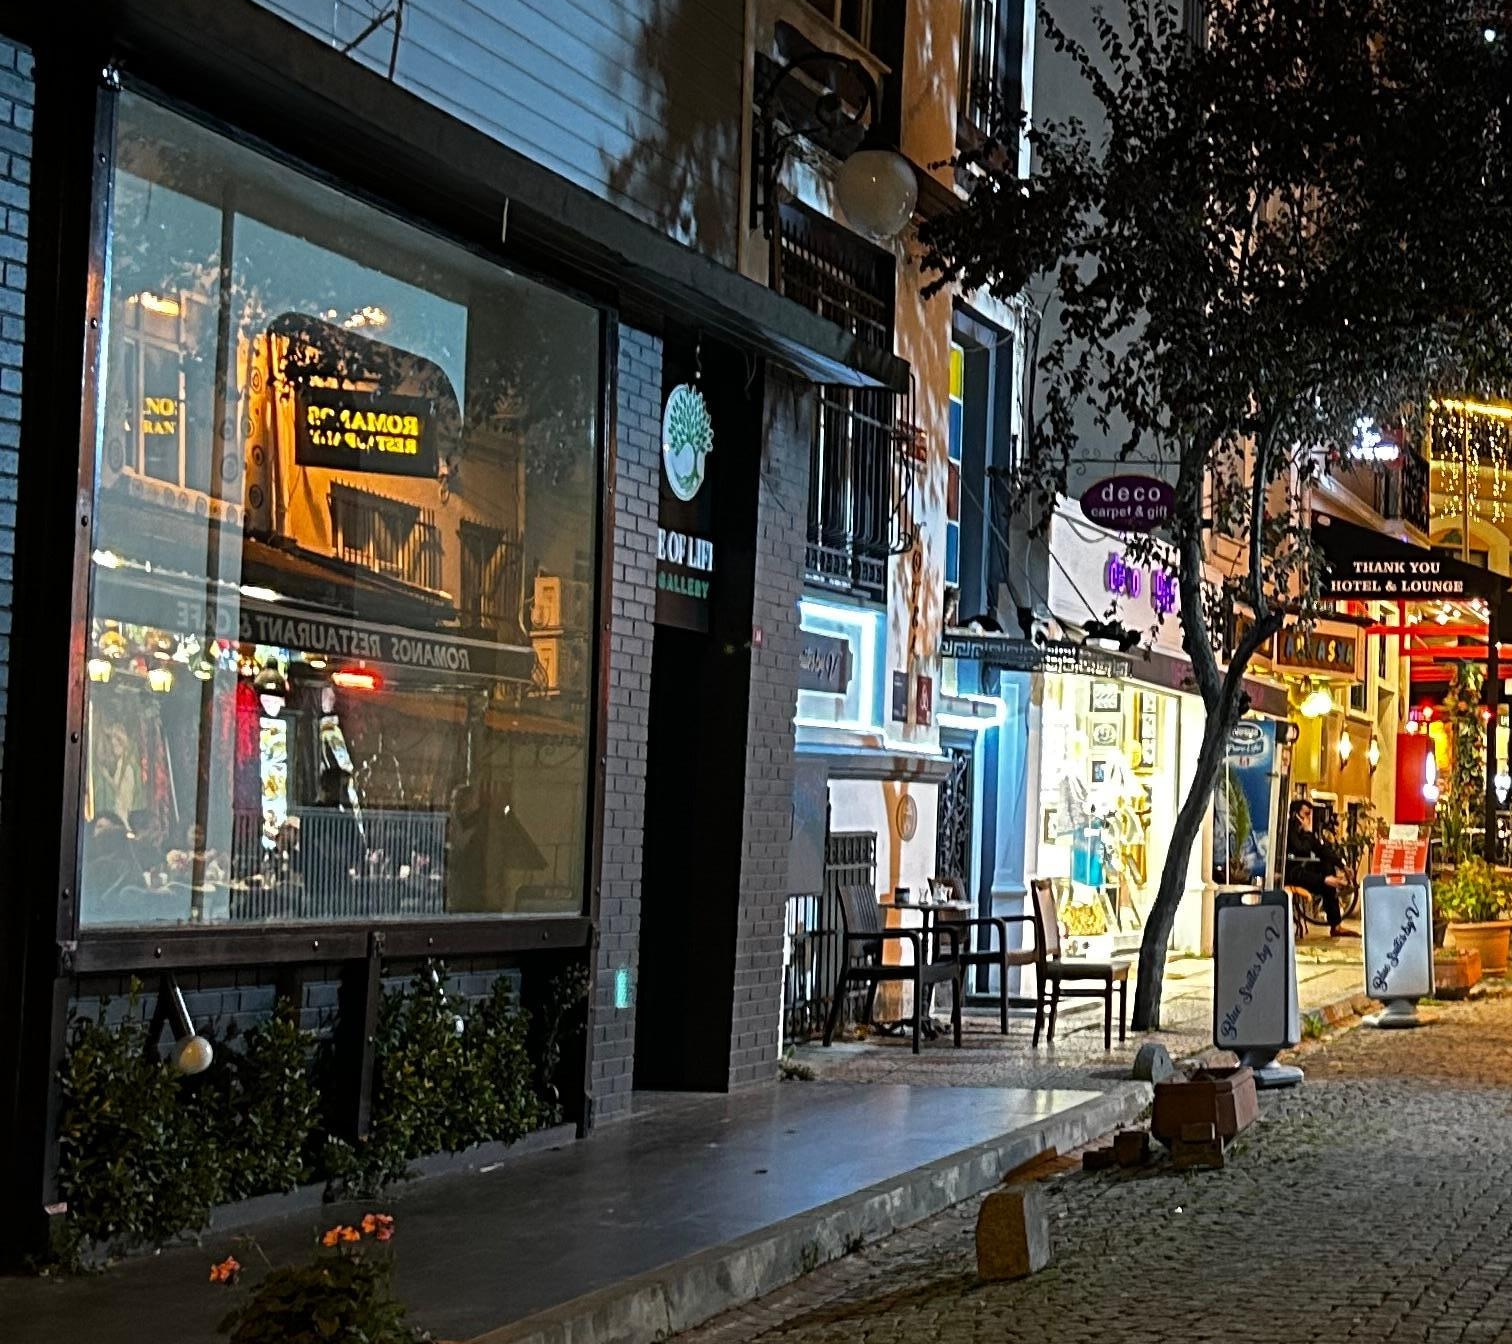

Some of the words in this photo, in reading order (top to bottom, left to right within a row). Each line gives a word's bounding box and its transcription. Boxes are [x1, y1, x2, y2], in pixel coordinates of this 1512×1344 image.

[1101, 482, 1161, 503] deco
[1090, 504, 1132, 521] carpet
[1134, 504, 1144, 518] &
[1147, 503, 1168, 521] gift
[667, 529, 687, 566] OF
[1352, 561, 1406, 574] THANK
[1409, 561, 1441, 574] YOU
[658, 570, 710, 599] GALLERY
[1330, 579, 1382, 593] HOTEL
[1385, 580, 1397, 593] &
[1401, 579, 1464, 593] LOUNGE
[1220, 1005, 1242, 1041] Blue
[1256, 943, 1273, 965] by
